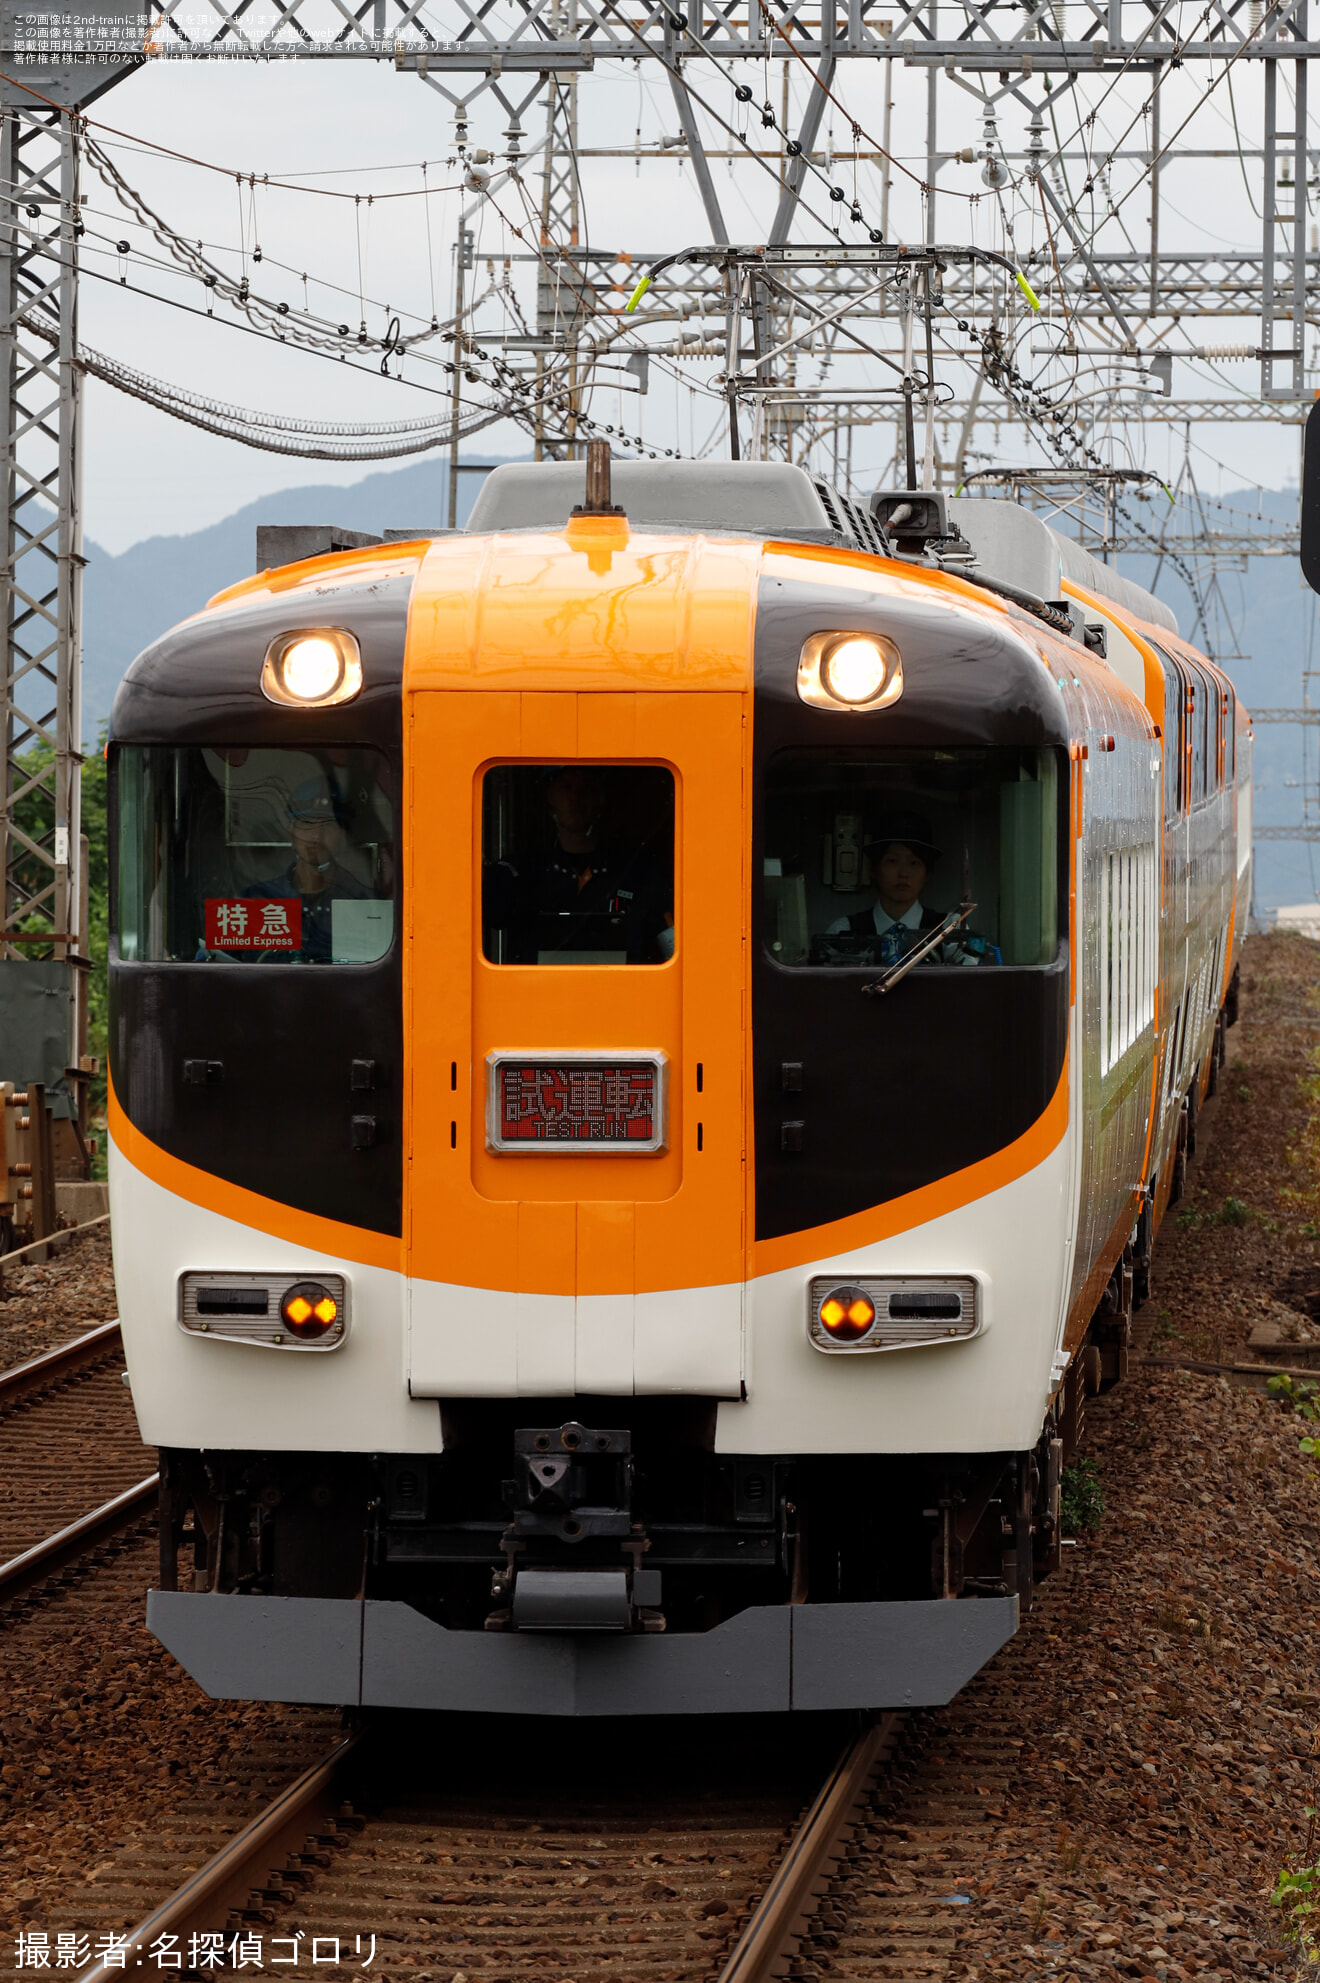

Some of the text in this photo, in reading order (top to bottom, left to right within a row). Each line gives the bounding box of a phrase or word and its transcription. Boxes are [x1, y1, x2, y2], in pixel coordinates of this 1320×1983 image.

[216, 903, 291, 936] 特急
[214, 936, 293, 948] Limited Express
[504, 1069, 654, 1121] 試運転
[534, 1121, 627, 1138] TEST RUN
